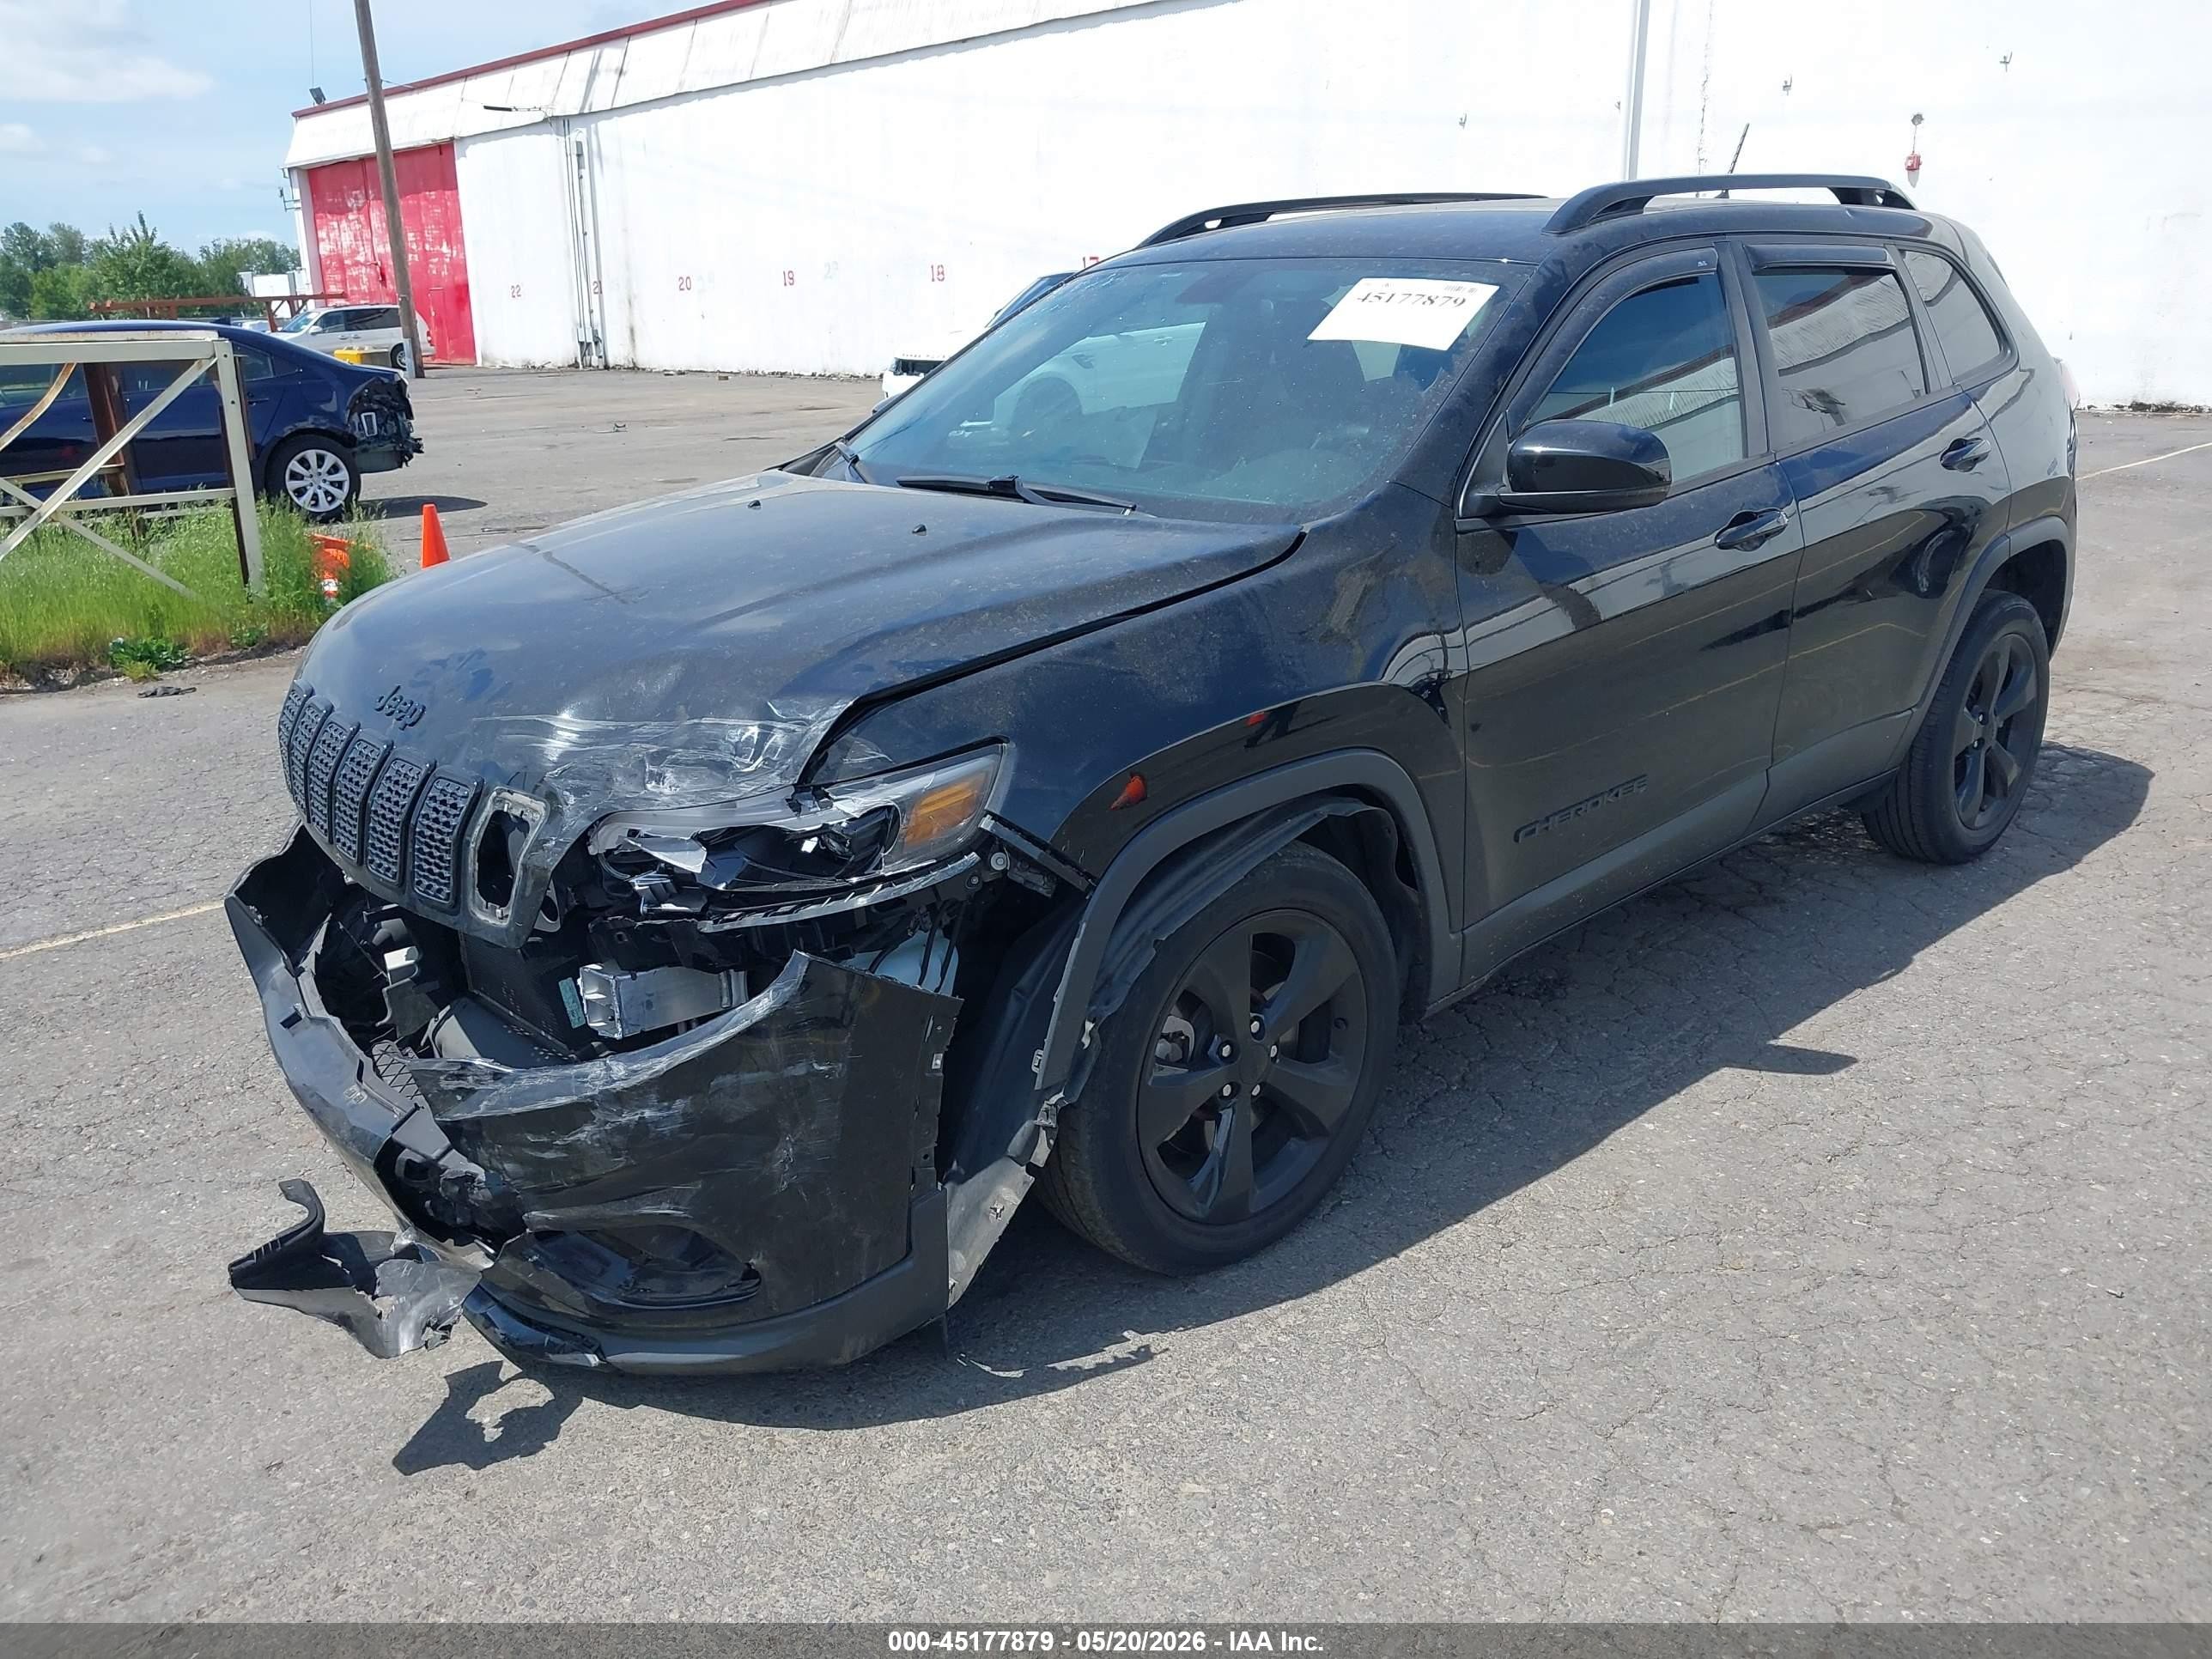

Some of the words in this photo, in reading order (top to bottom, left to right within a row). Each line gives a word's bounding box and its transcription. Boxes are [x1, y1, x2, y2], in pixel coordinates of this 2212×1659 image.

[782, 269, 795, 287] 19
[930, 264, 945, 283] 18
[510, 283, 522, 299] 22
[679, 276, 692, 292] 20
[1356, 291, 1467, 308] 45177879
[374, 684, 427, 732] Jeep
[1513, 773, 1648, 843] CHEROKEE
